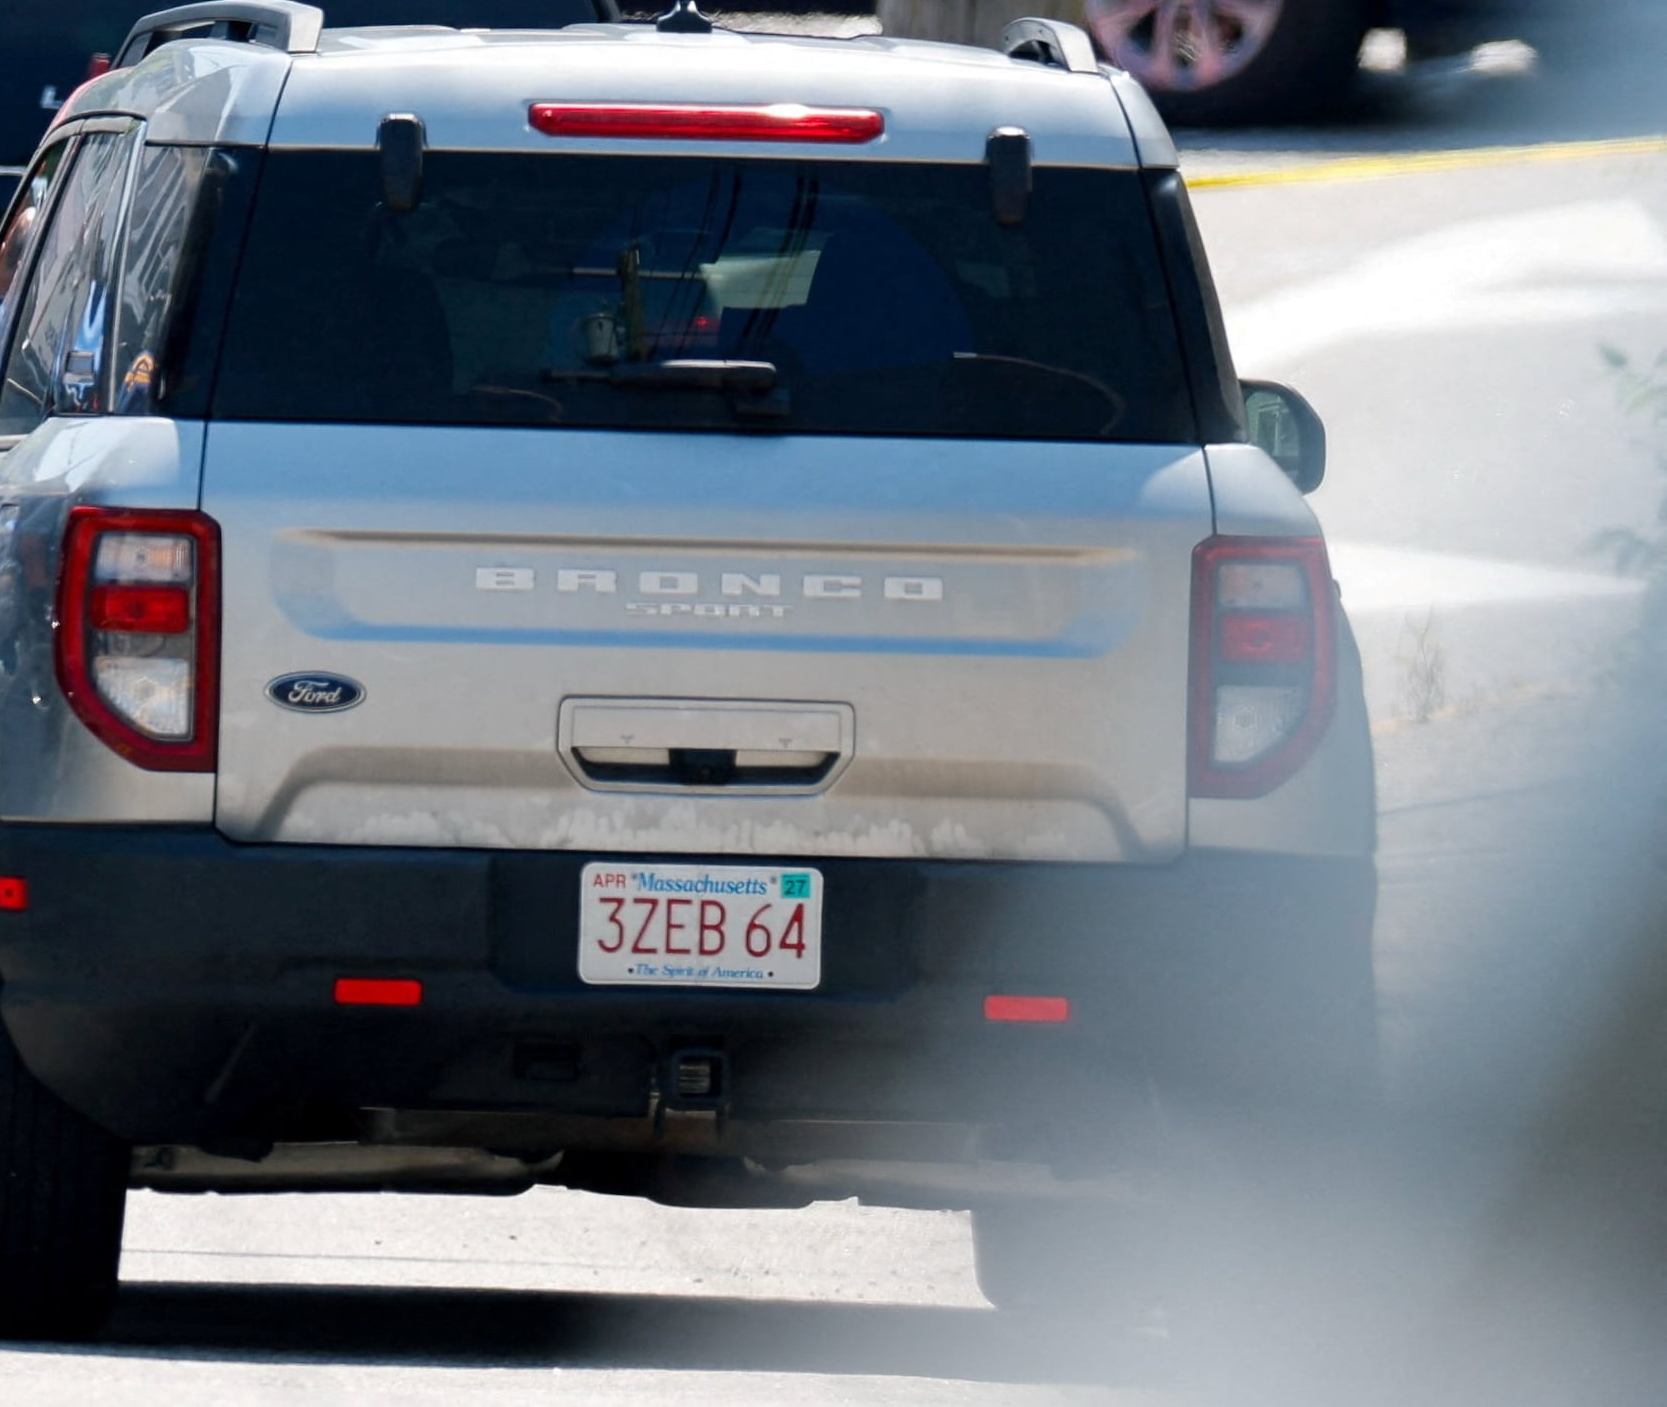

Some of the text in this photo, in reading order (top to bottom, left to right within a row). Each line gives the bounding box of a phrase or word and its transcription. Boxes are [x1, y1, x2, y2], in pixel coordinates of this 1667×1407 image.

[475, 567, 944, 601] BRONCO
[625, 602, 794, 618] SPORT
[287, 679, 343, 704] Ford
[593, 872, 807, 896] APR Massachusetts 27
[597, 897, 806, 959] 3ZEB 64
[636, 963, 764, 979] The Spirit of America
